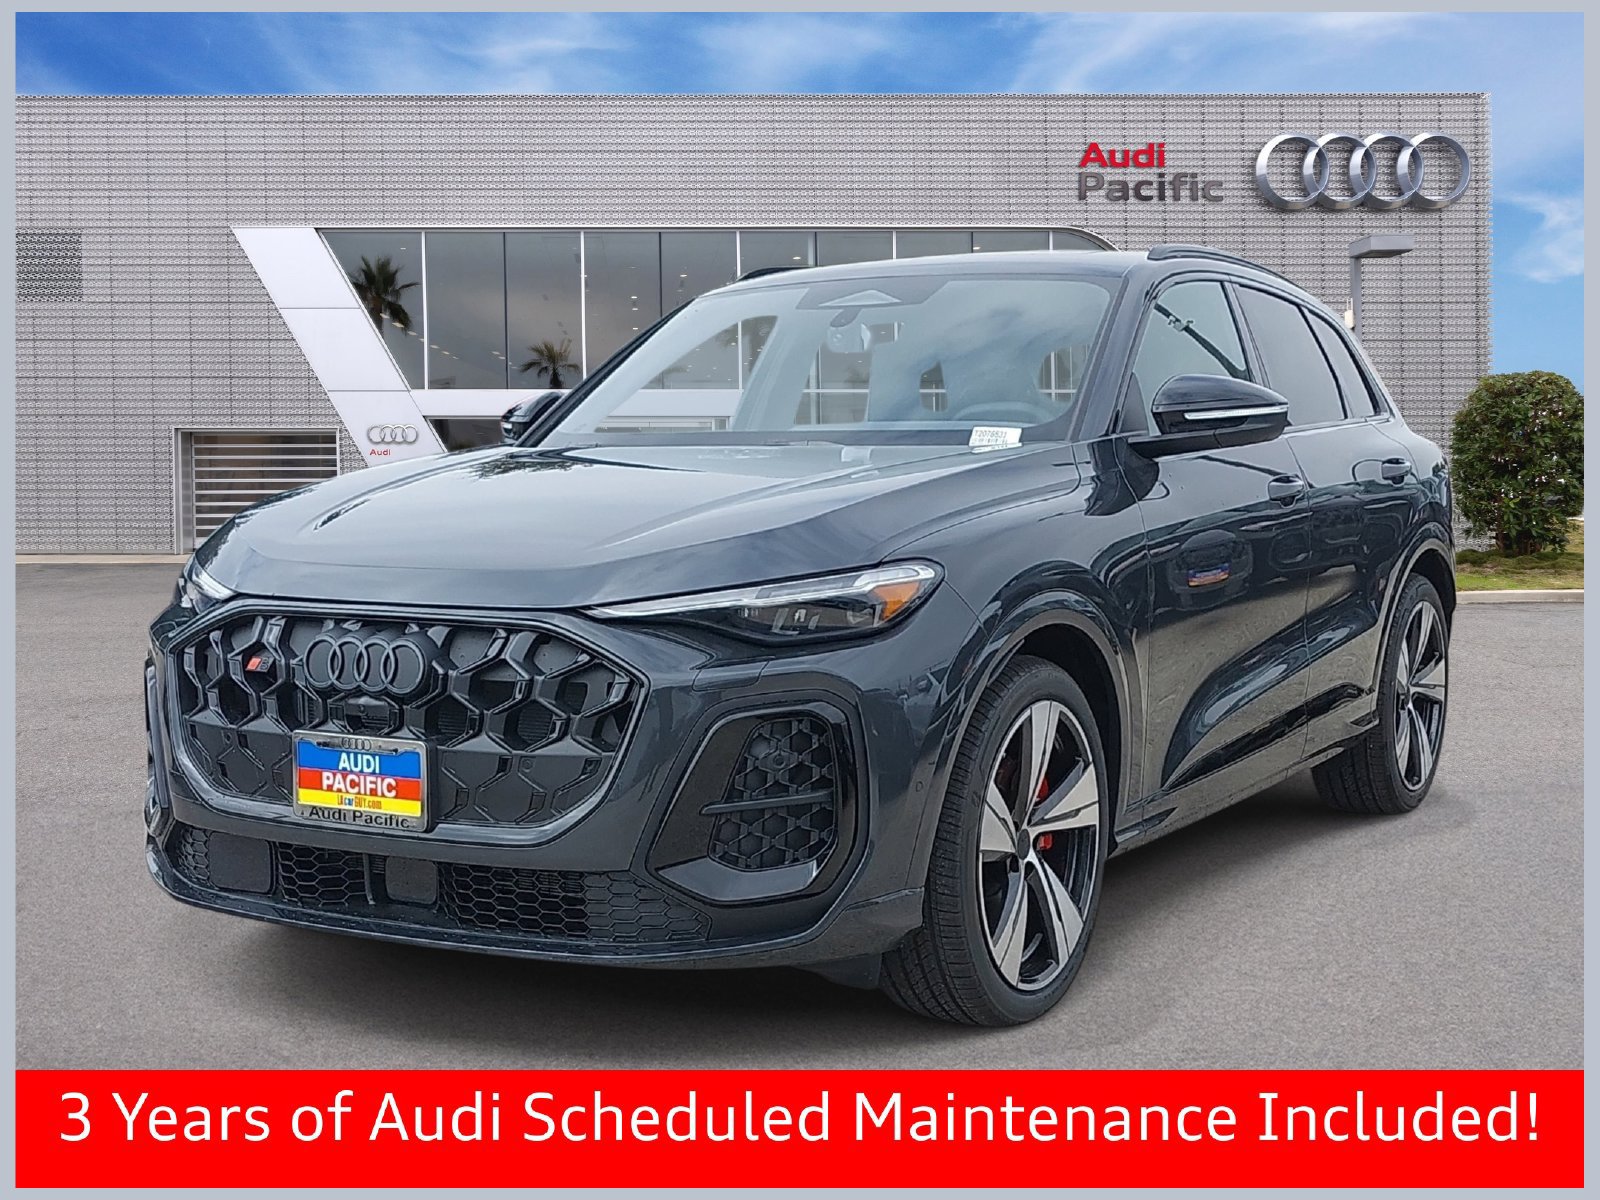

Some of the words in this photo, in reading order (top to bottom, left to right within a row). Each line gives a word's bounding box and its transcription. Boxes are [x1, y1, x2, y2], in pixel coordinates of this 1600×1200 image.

[1079, 142, 1166, 168] Audi
[1078, 171, 1224, 202] Pacific
[369, 448, 391, 456] Audi
[338, 752, 380, 774] AUDI
[321, 771, 397, 798] PACIFIC
[308, 806, 347, 822] Audi
[352, 809, 410, 830] Pacific
